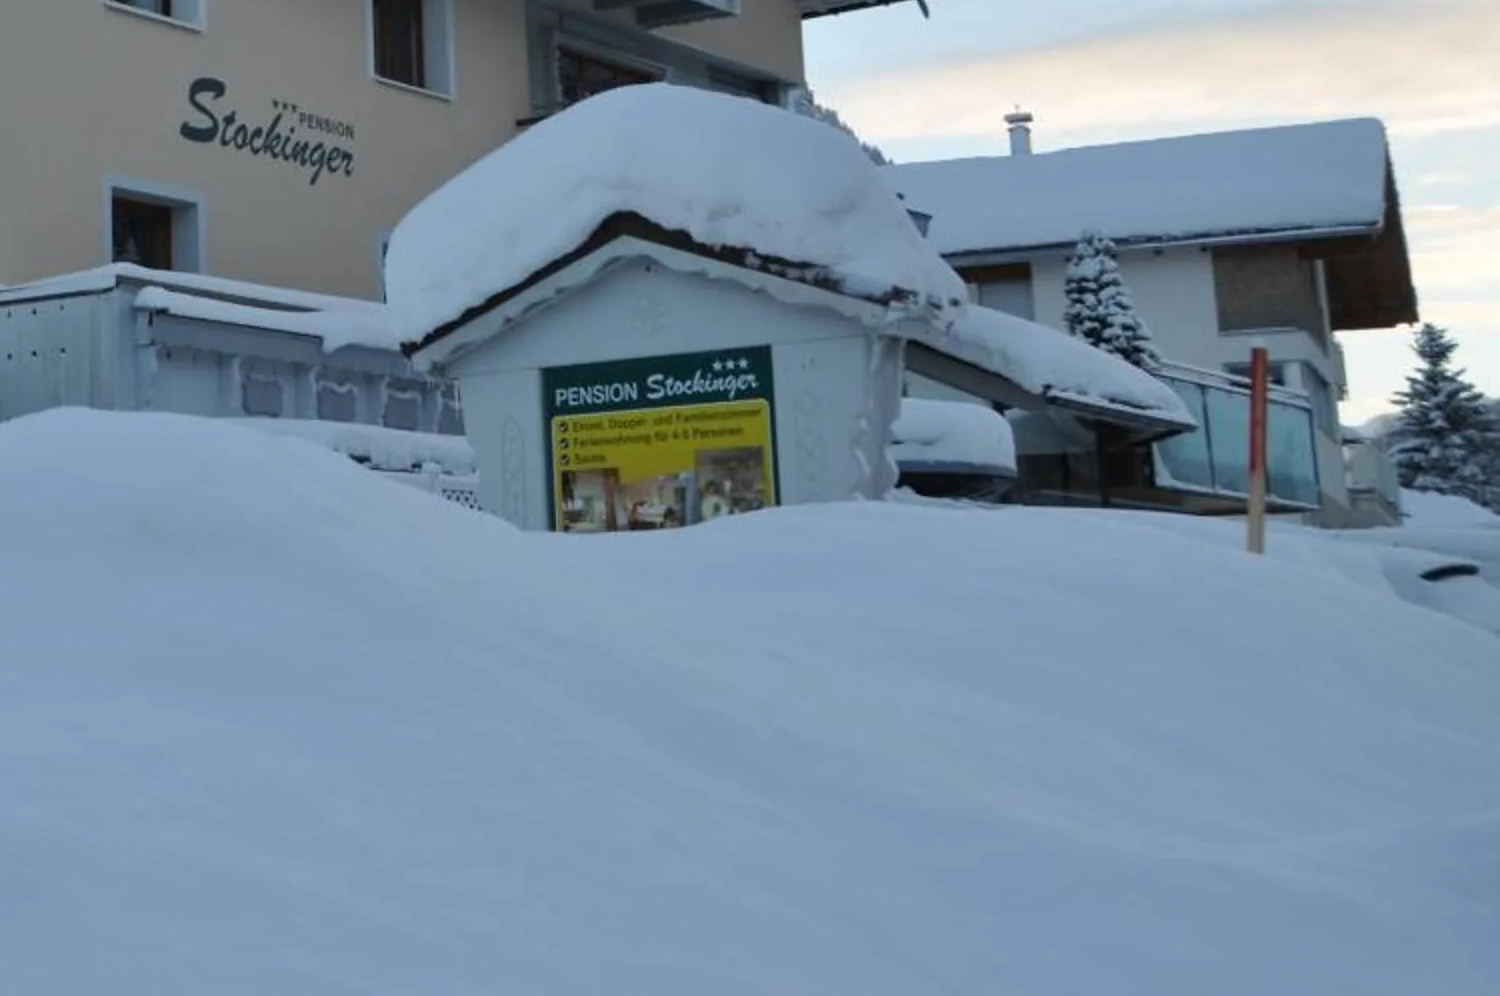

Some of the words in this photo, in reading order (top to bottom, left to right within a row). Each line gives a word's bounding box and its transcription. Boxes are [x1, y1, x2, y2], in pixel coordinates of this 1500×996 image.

[179, 77, 355, 186] Stockinger
[299, 111, 355, 140] PENSION
[555, 382, 638, 407] PENSION
[646, 369, 760, 400] Stockinger
